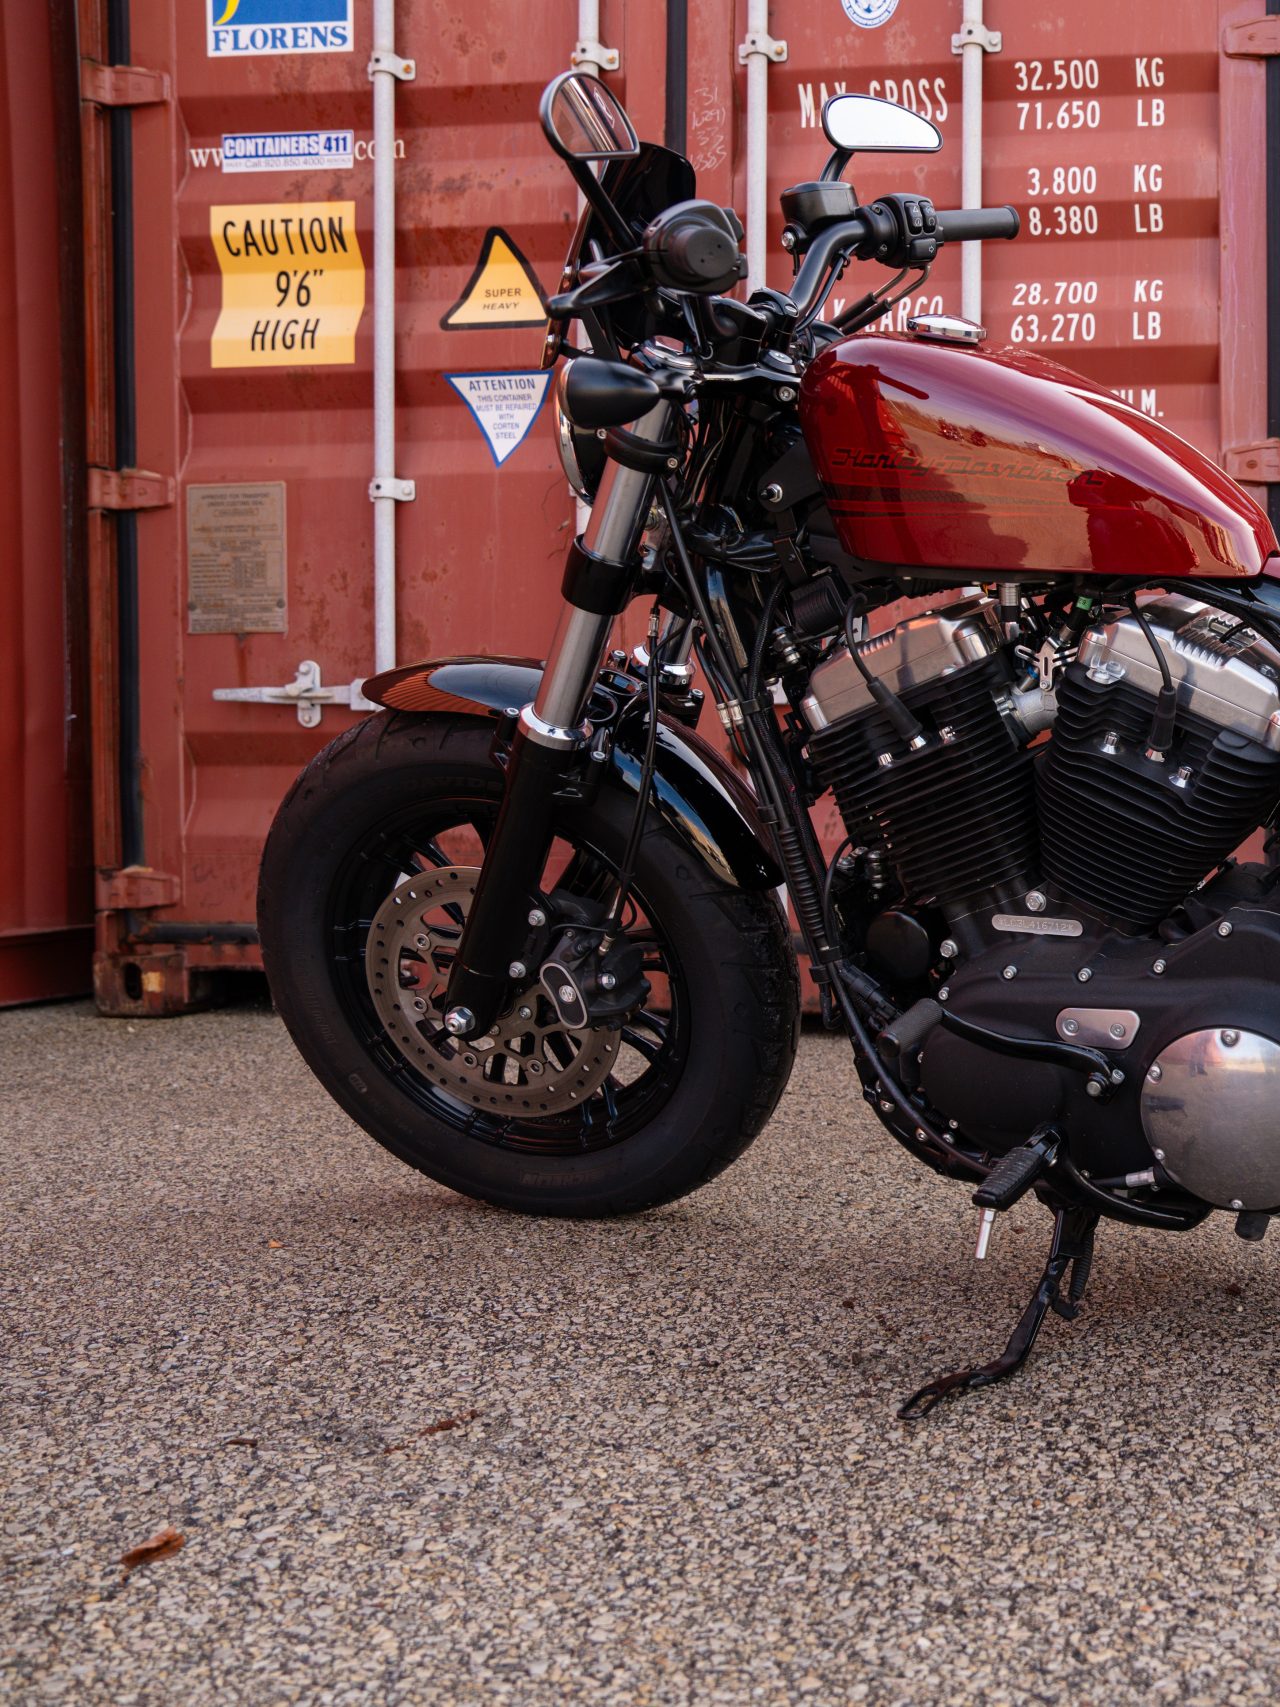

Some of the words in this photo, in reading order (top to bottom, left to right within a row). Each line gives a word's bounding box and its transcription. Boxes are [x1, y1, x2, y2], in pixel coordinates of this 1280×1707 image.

[213, 26, 348, 51] FLORENS
[1014, 59, 1099, 91] 32,500
[1135, 57, 1165, 88] KG
[1016, 100, 1101, 130] 71,650
[1137, 99, 1165, 127] LB
[224, 137, 319, 158] CONTAINERS
[323, 135, 348, 152] 411
[1027, 166, 1097, 196] 3,800
[1133, 164, 1163, 193] KG
[1028, 205, 1099, 236] 8,380
[1135, 204, 1164, 233] LB
[223, 217, 348, 257] CAUTION
[482, 302, 520, 310] HEAVY
[485, 288, 522, 298] SUPER
[1012, 281, 1098, 305] 28,700
[1133, 280, 1164, 303] KG
[251, 319, 320, 352] HIGH
[1010, 313, 1096, 342] 63,270
[1132, 312, 1162, 340] LB
[469, 378, 536, 392] ATTENTION
